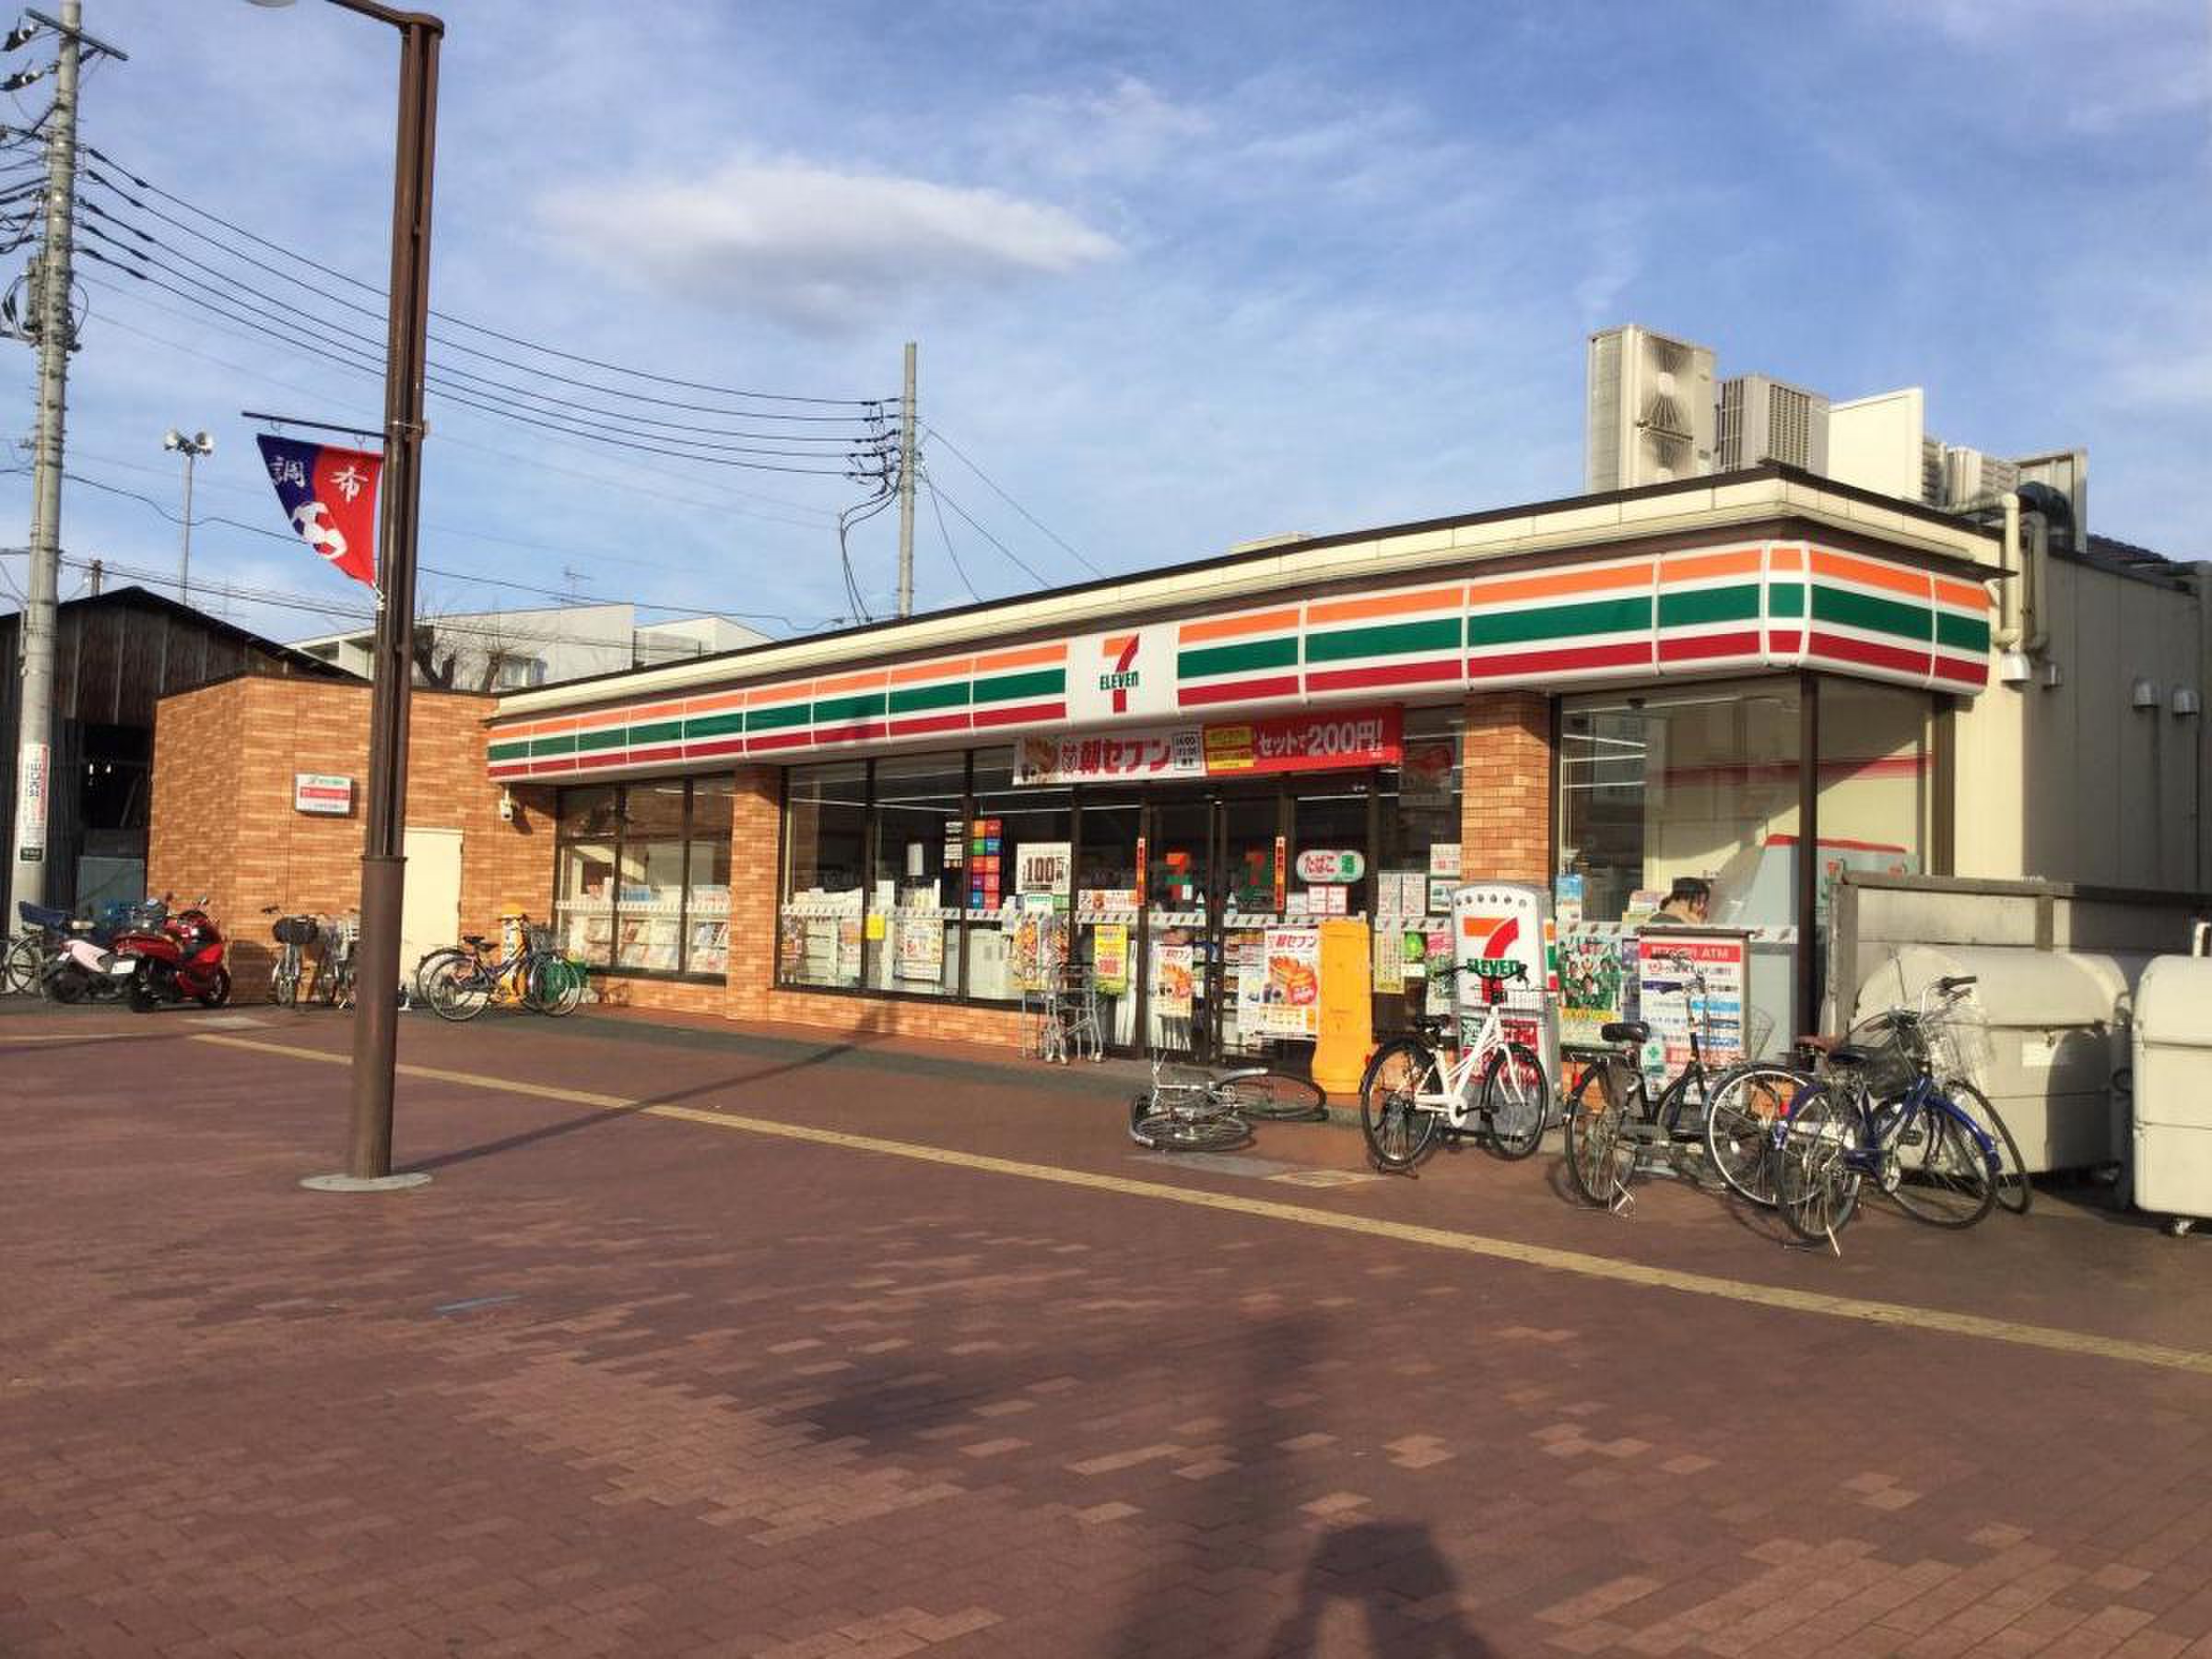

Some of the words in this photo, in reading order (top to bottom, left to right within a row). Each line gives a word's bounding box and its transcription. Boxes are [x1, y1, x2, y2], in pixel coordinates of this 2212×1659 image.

[1103, 633, 1139, 713] 7
[1463, 916, 1520, 1003] 7
[1701, 947, 1729, 959] ATM
